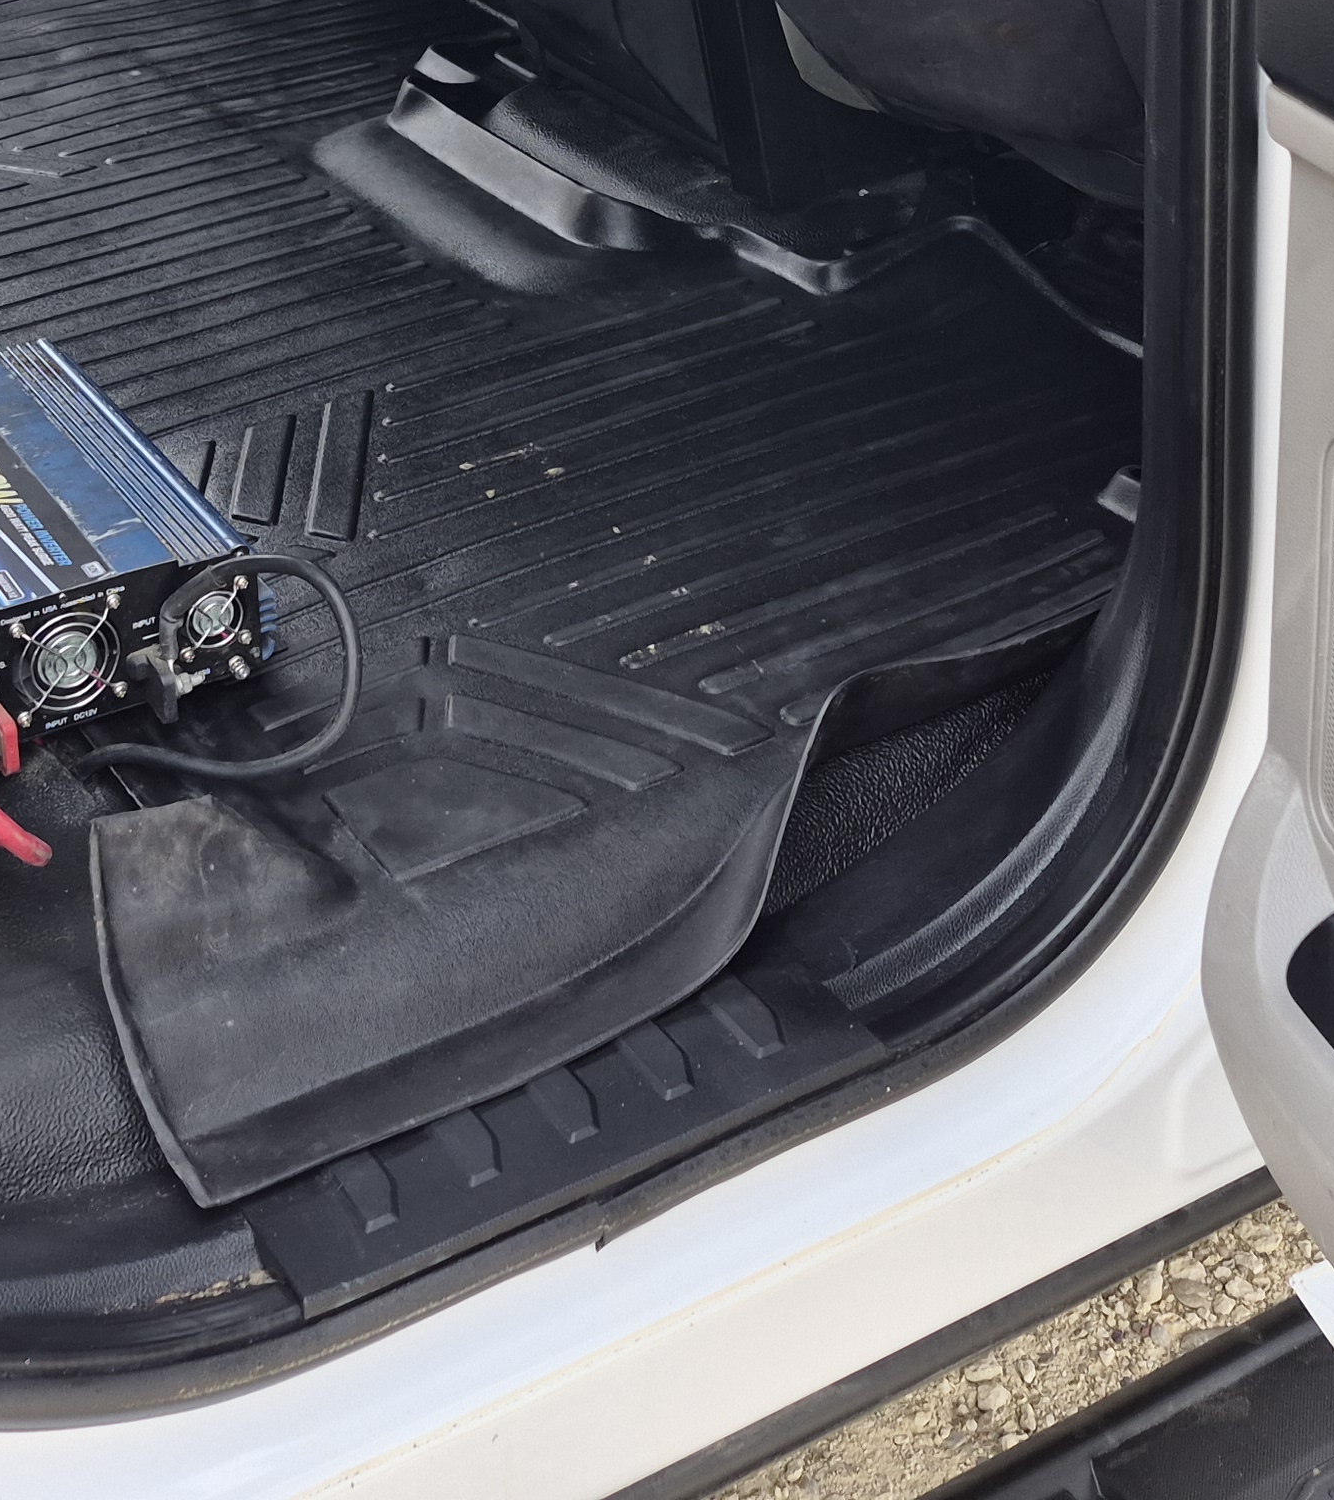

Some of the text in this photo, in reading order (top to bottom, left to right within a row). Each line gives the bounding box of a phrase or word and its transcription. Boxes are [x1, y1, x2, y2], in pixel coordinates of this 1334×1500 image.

[12, 503, 73, 567] POWER INVERTER
[42, 604, 58, 614] USA
[132, 616, 156, 630] INPUT
[45, 716, 69, 730] INPUT
